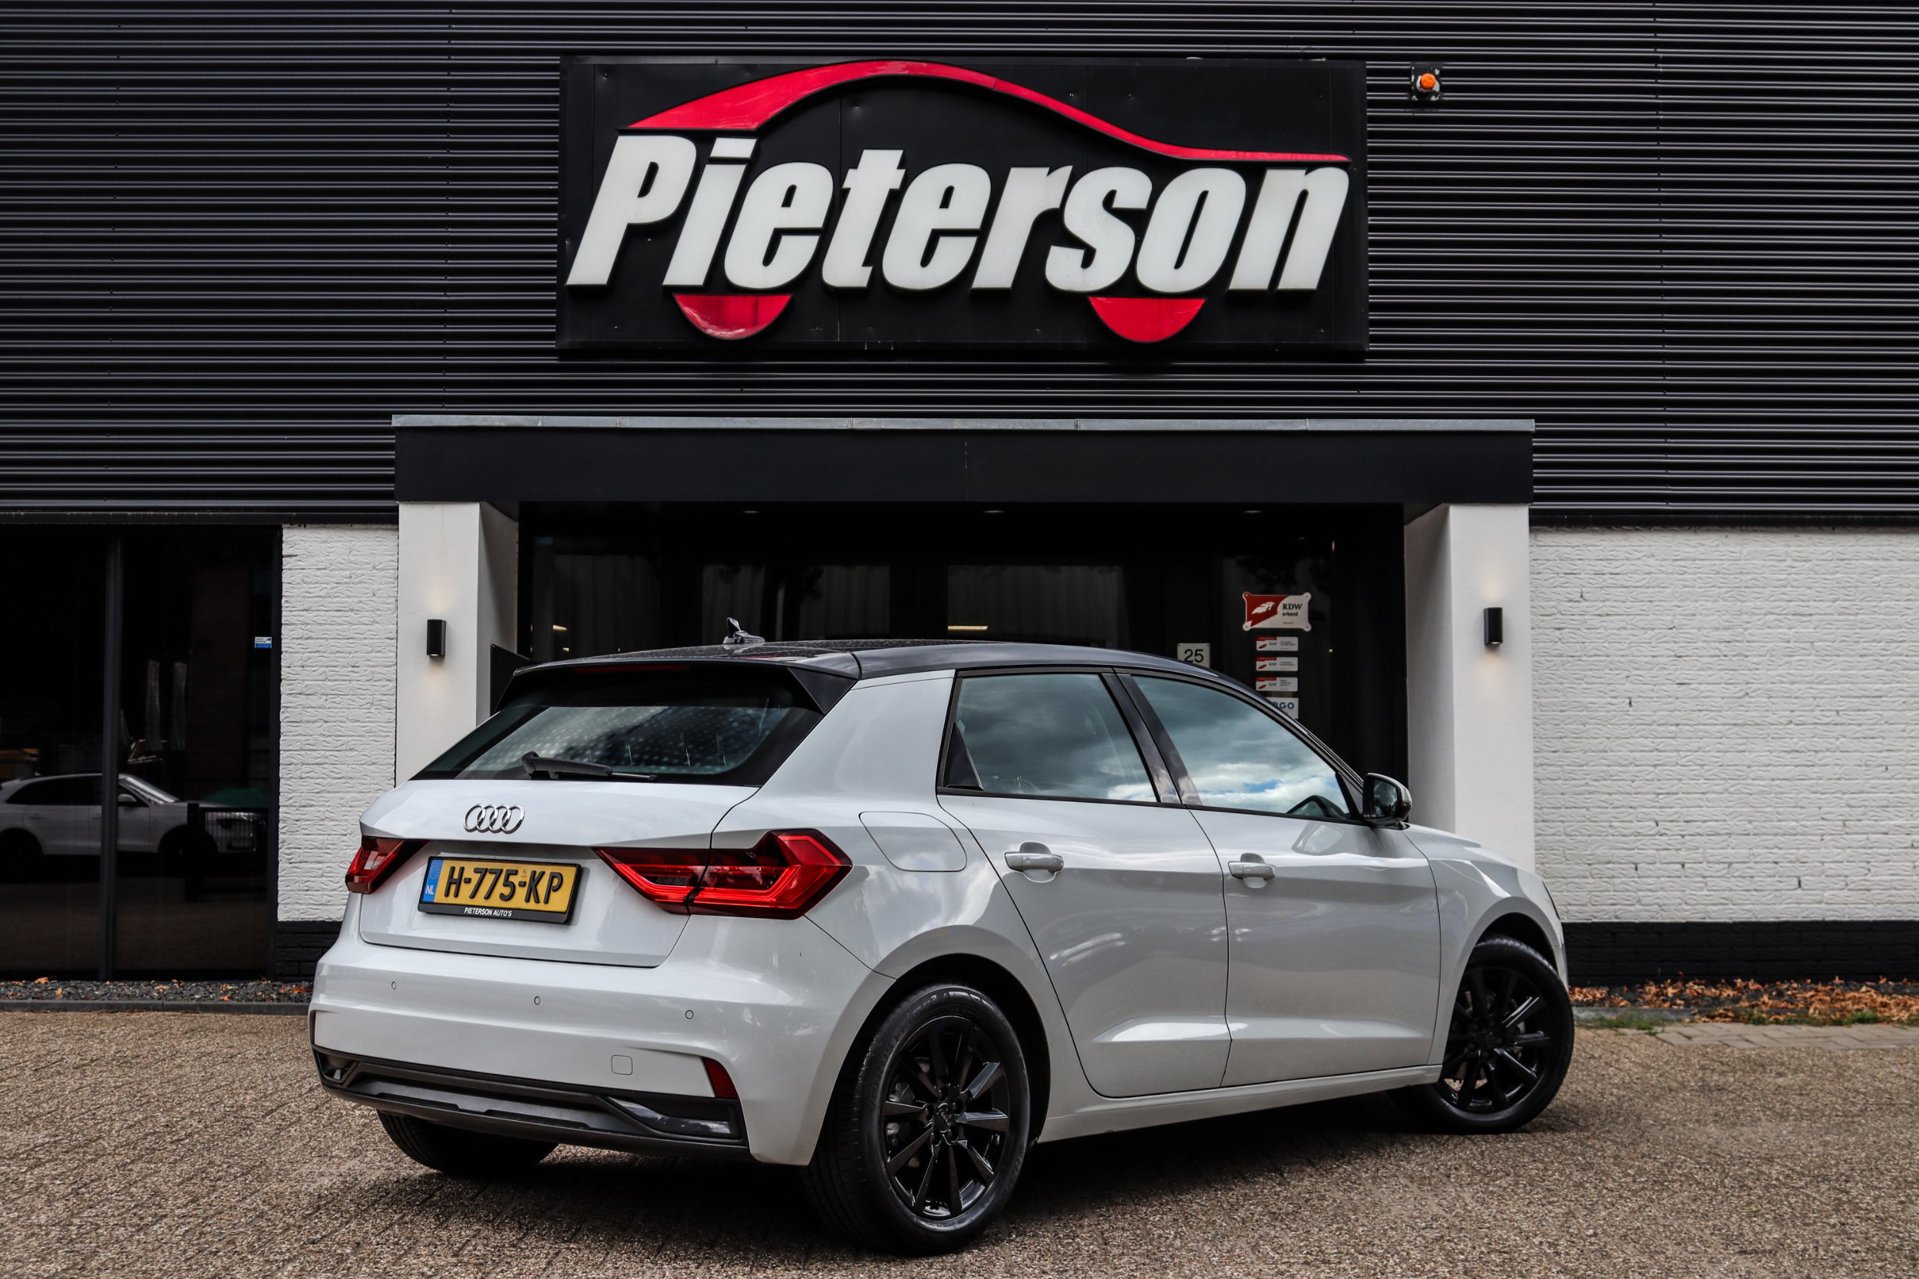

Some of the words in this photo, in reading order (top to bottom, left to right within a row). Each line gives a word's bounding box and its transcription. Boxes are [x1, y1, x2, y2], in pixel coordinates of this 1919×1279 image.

[566, 134, 1350, 293] Pieterson
[1184, 649, 1204, 663] 25
[425, 885, 434, 895] NL
[444, 866, 563, 904] H-775-KP
[463, 907, 493, 916] PIETERSON
[493, 909, 512, 917] AUTO'S
